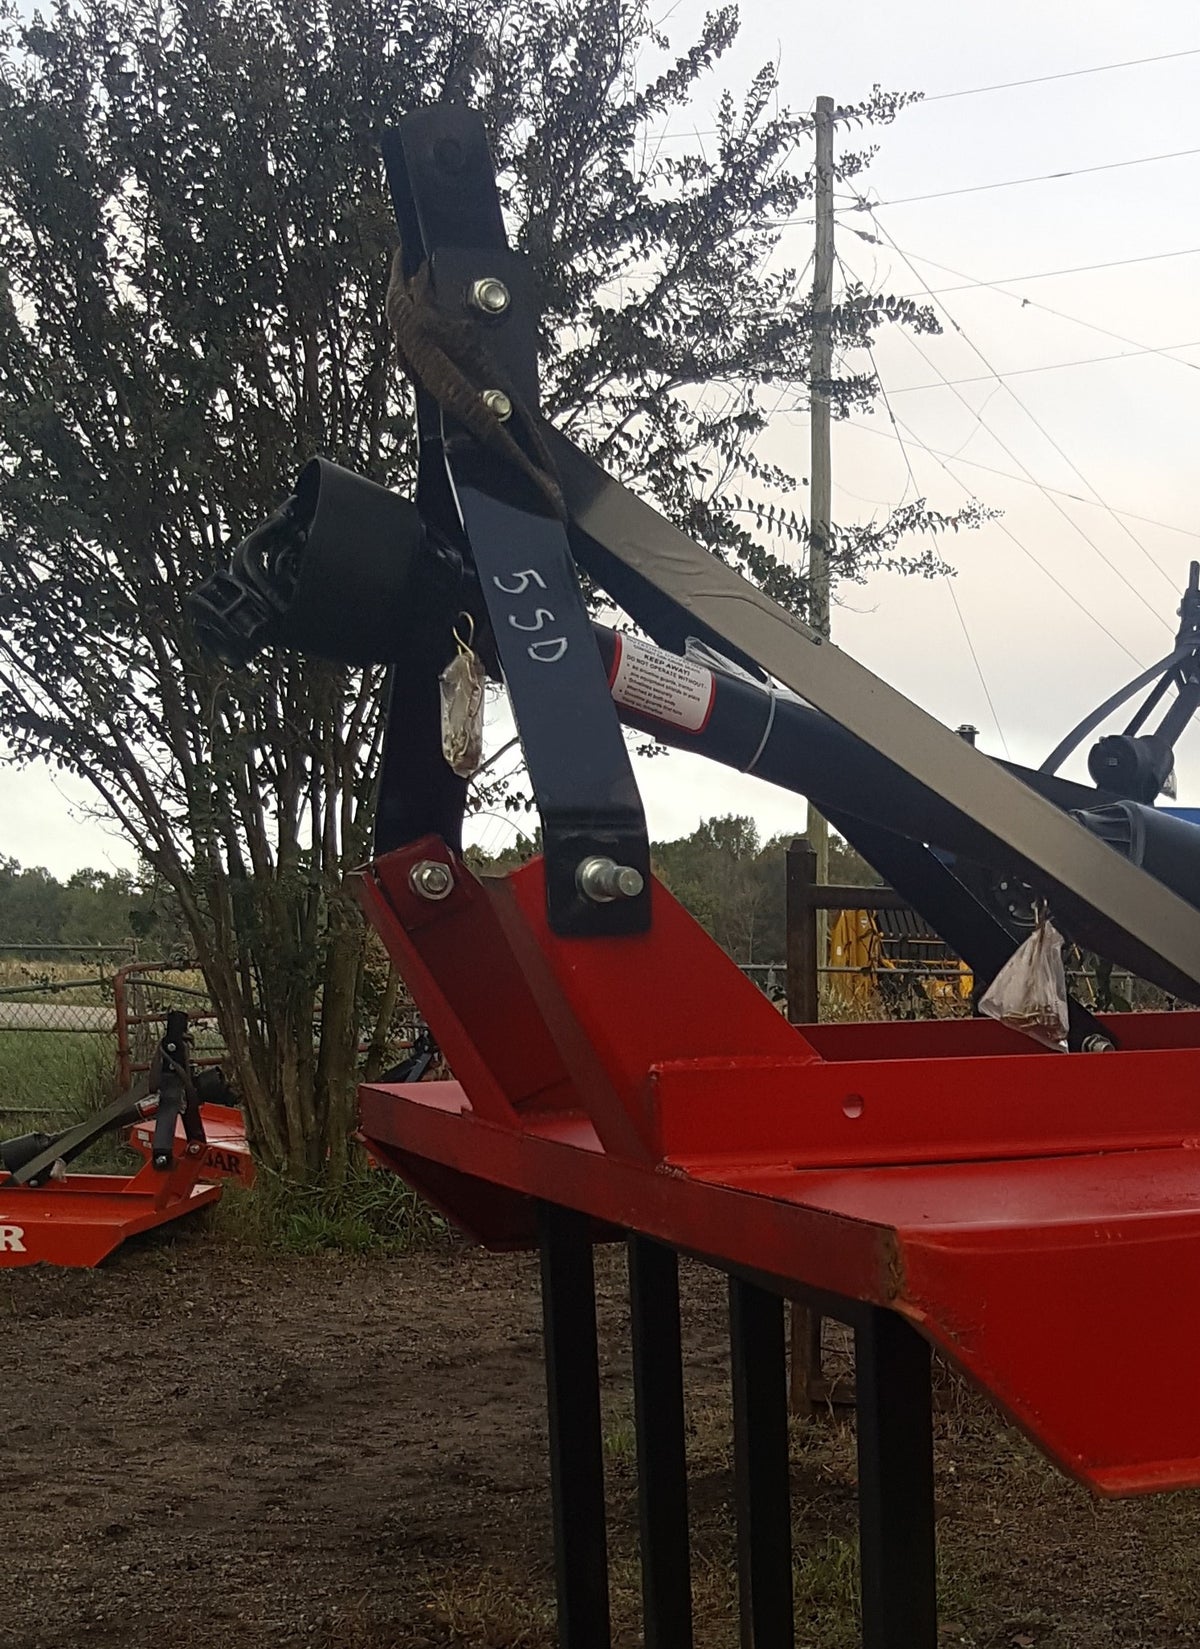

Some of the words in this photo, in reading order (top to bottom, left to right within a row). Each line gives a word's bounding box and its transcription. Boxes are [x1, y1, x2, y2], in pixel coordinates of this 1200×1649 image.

[643, 654, 664, 665] KEEP
[636, 658, 648, 666] NOT
[648, 663, 676, 677] OPERATE
